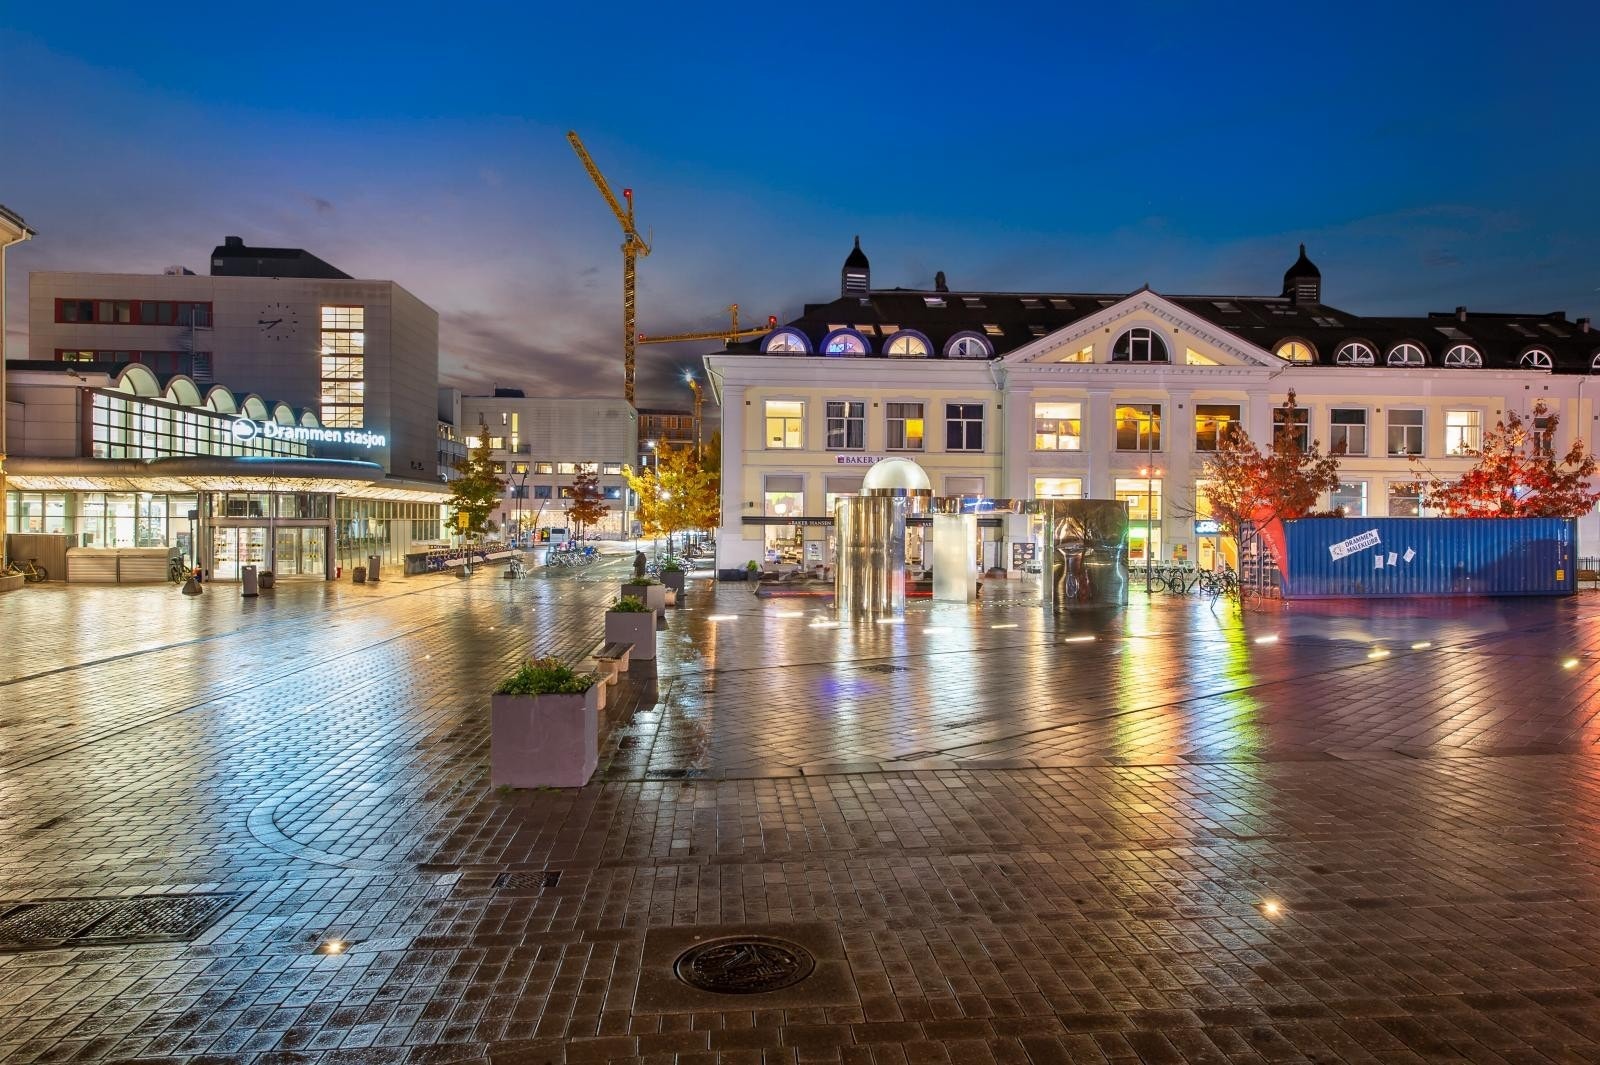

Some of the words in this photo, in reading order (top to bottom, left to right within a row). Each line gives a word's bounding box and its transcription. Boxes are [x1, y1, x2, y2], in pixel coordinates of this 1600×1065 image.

[264, 421, 342, 442] Drammen
[344, 430, 386, 448] stasjon
[846, 456, 874, 464] BAKER
[1344, 532, 1374, 547] DRAMMEN
